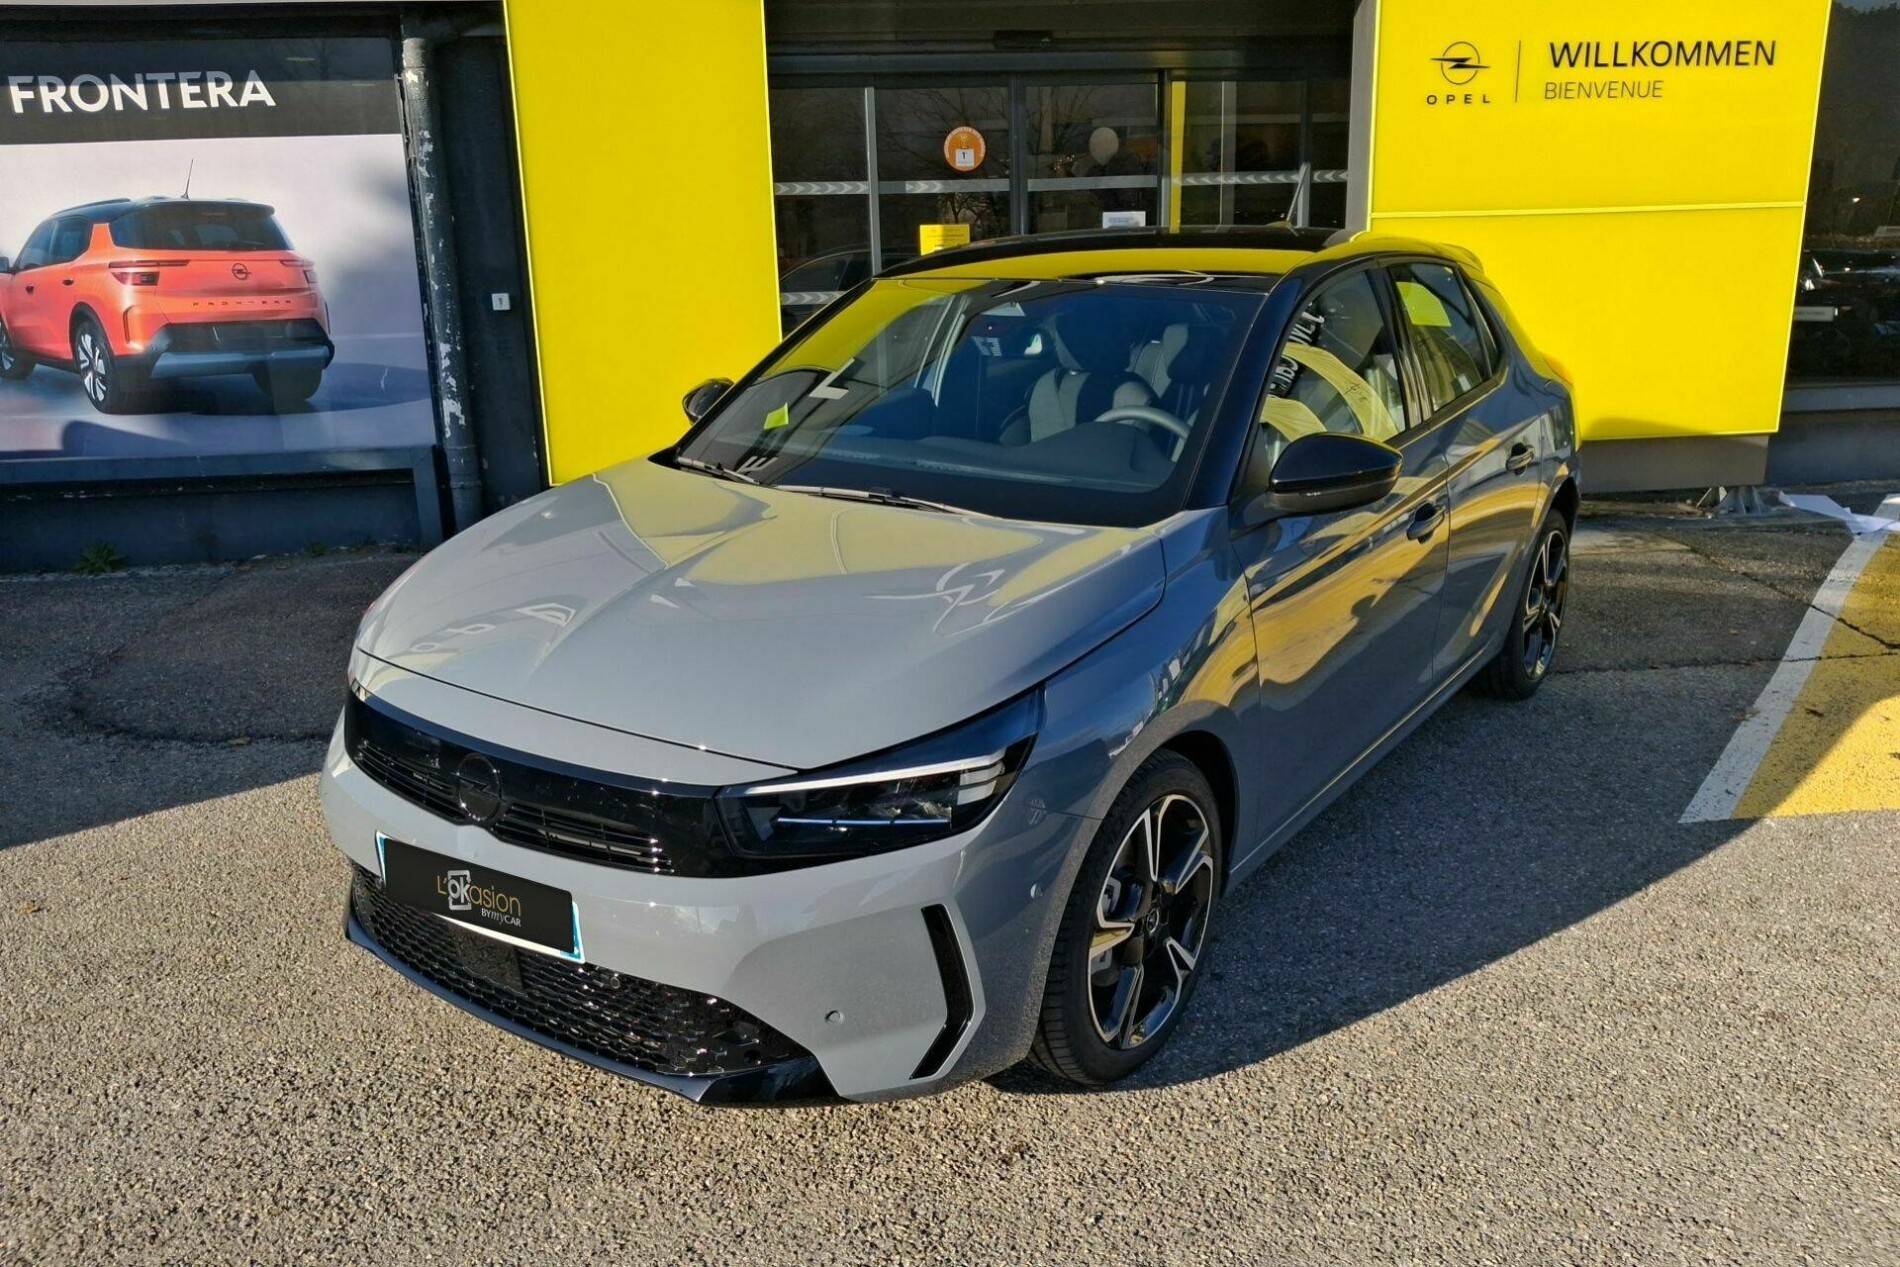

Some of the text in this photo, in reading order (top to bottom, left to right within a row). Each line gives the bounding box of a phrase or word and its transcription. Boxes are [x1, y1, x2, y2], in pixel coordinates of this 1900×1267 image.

[1549, 40, 1777, 68] WILLKOMMEN
[7, 69, 277, 114] FRONTERA
[1426, 94, 1491, 105] OPEL
[1543, 80, 1664, 100] BIENVENUE
